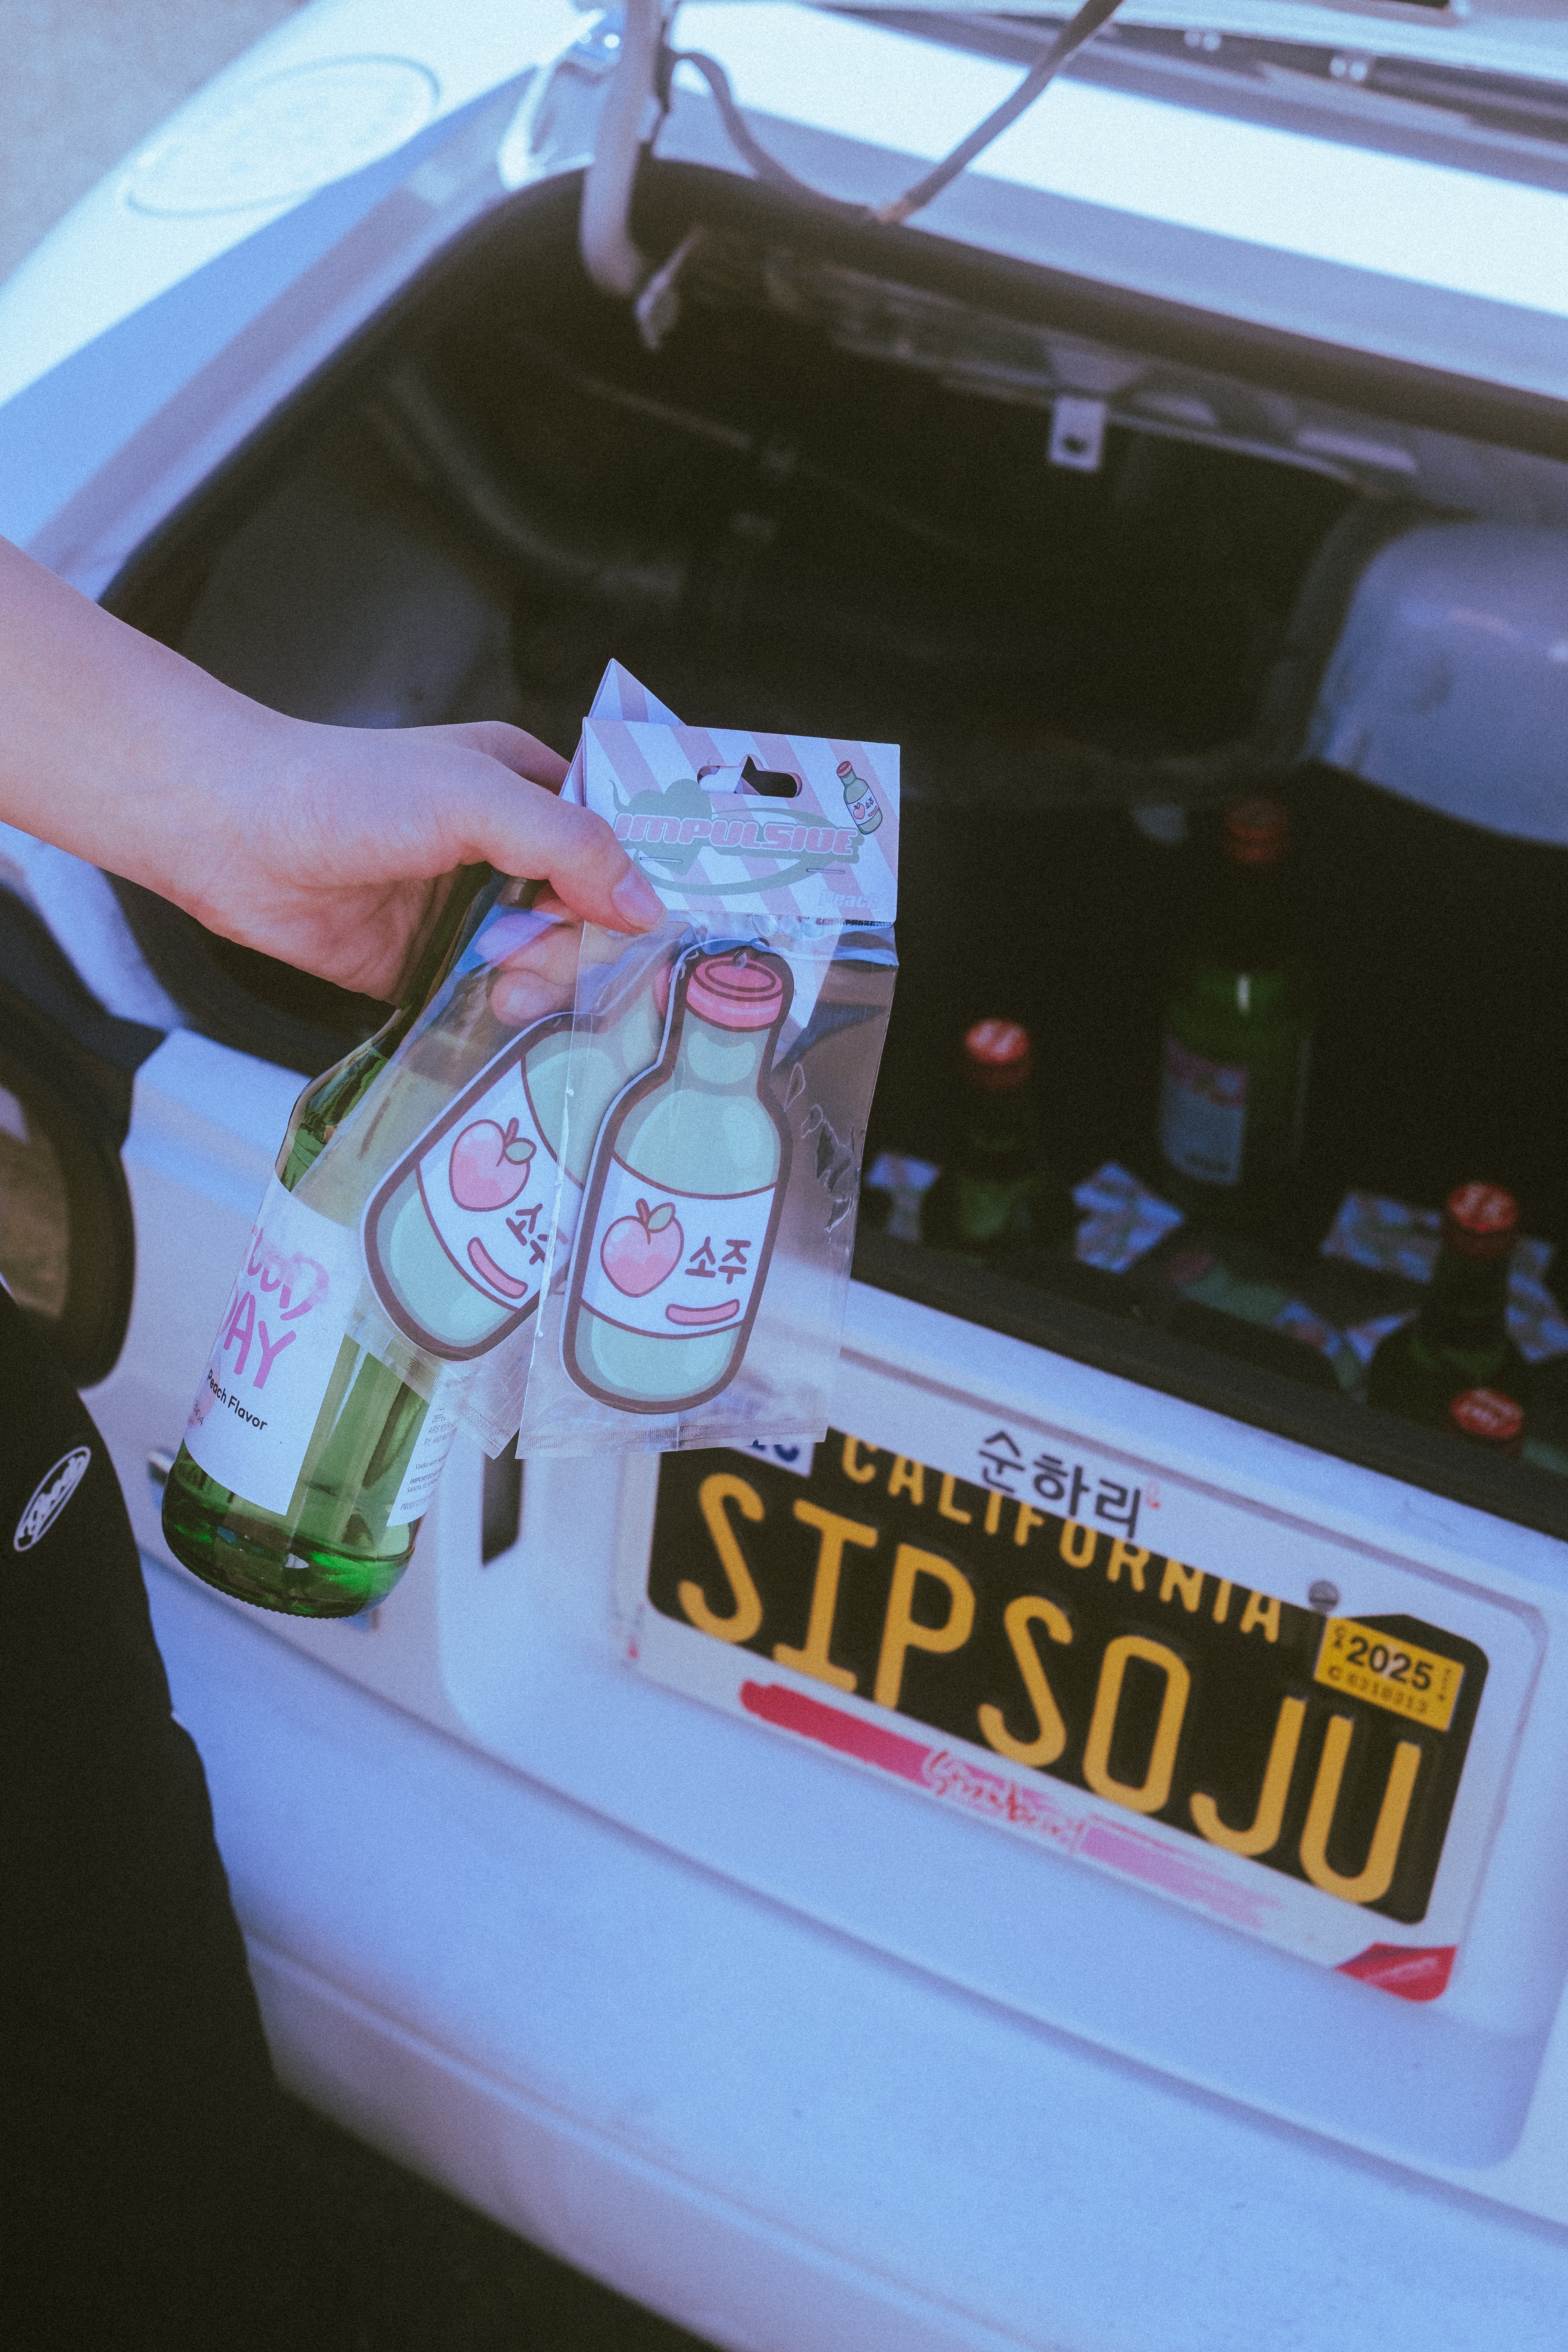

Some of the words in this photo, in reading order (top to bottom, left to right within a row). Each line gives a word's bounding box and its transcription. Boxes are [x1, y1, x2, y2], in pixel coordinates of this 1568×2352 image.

[817, 889, 879, 909] Peach
[685, 1236, 751, 1284] 소주
[207, 1369, 227, 1404] Peach
[227, 1395, 267, 1430] Flavor
[978, 1430, 1141, 1540] 순하리
[841, 1435, 1281, 1644] CALIFORNIA
[677, 1472, 1423, 1904] SIPSOJU
[1345, 1635, 1434, 1690] 2025
